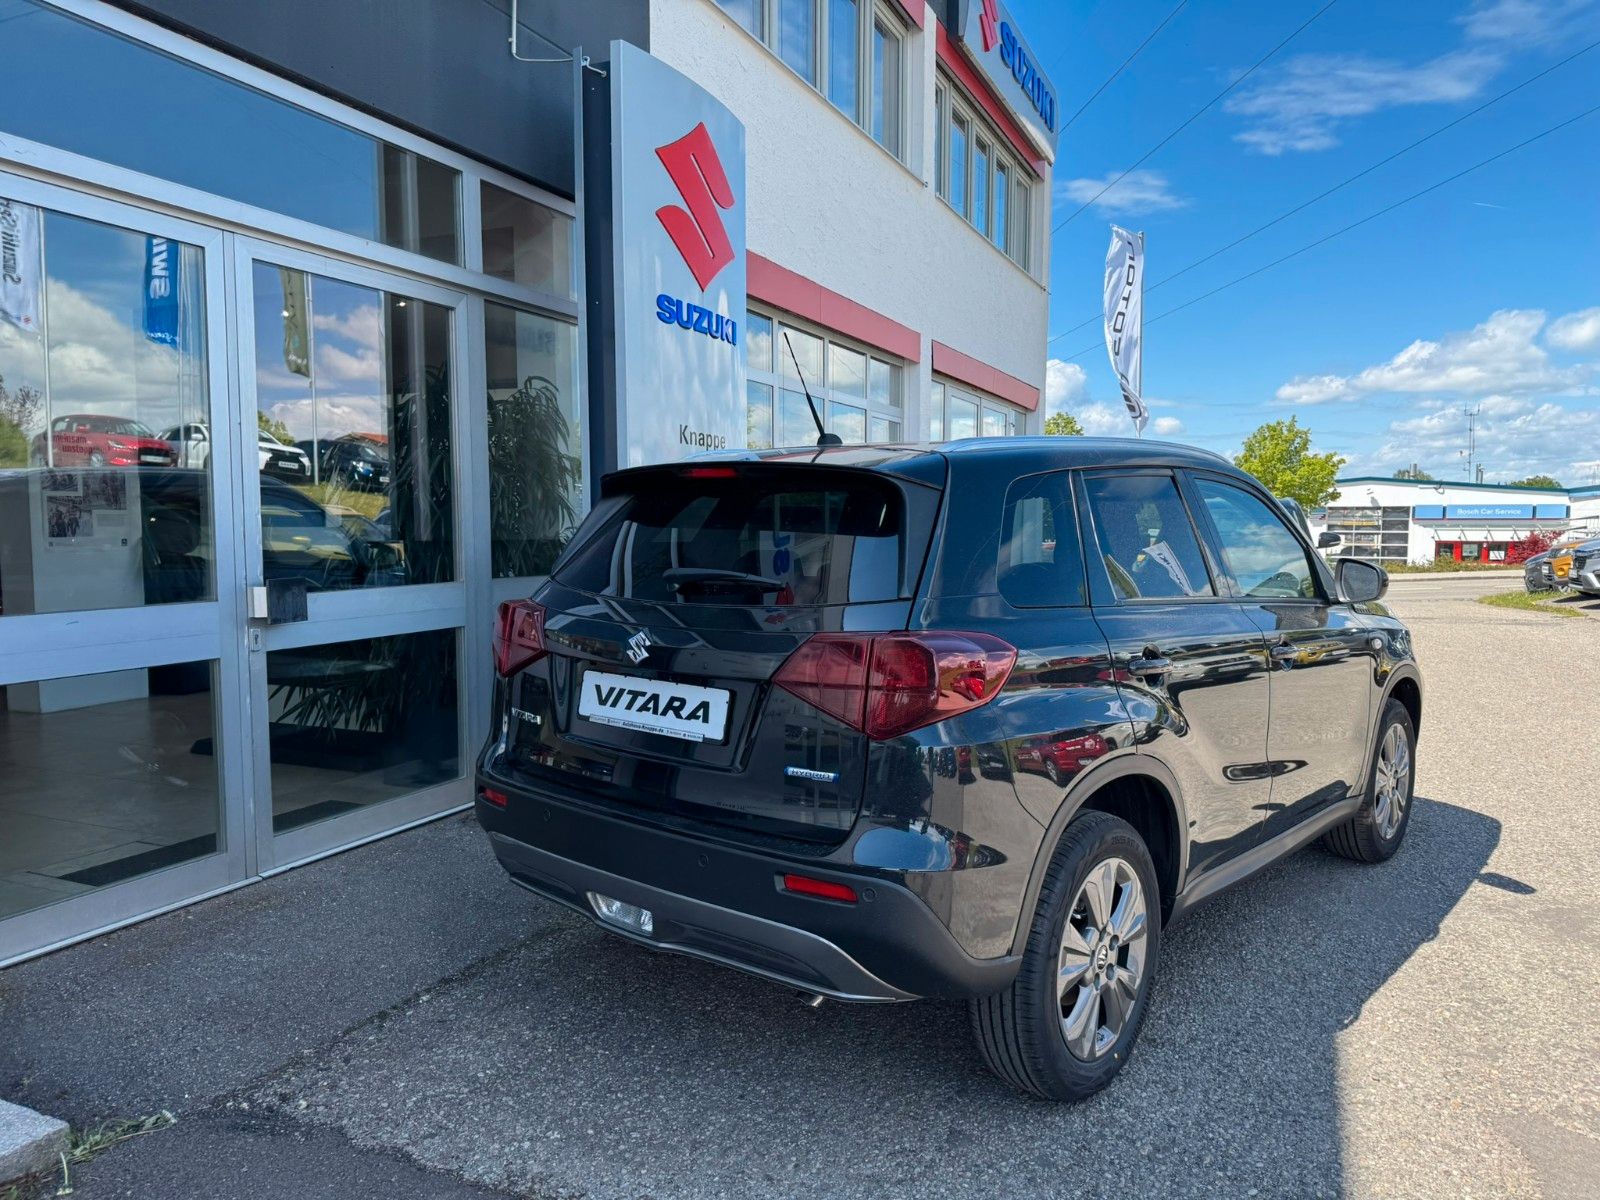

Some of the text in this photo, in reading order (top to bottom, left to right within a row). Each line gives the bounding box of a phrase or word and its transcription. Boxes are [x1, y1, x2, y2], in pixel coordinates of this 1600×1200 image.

[1000, 21, 1055, 133] SUZUKI
[656, 293, 737, 347] SUZUKI
[680, 424, 726, 451] Knappe
[595, 684, 710, 724] VITARA
